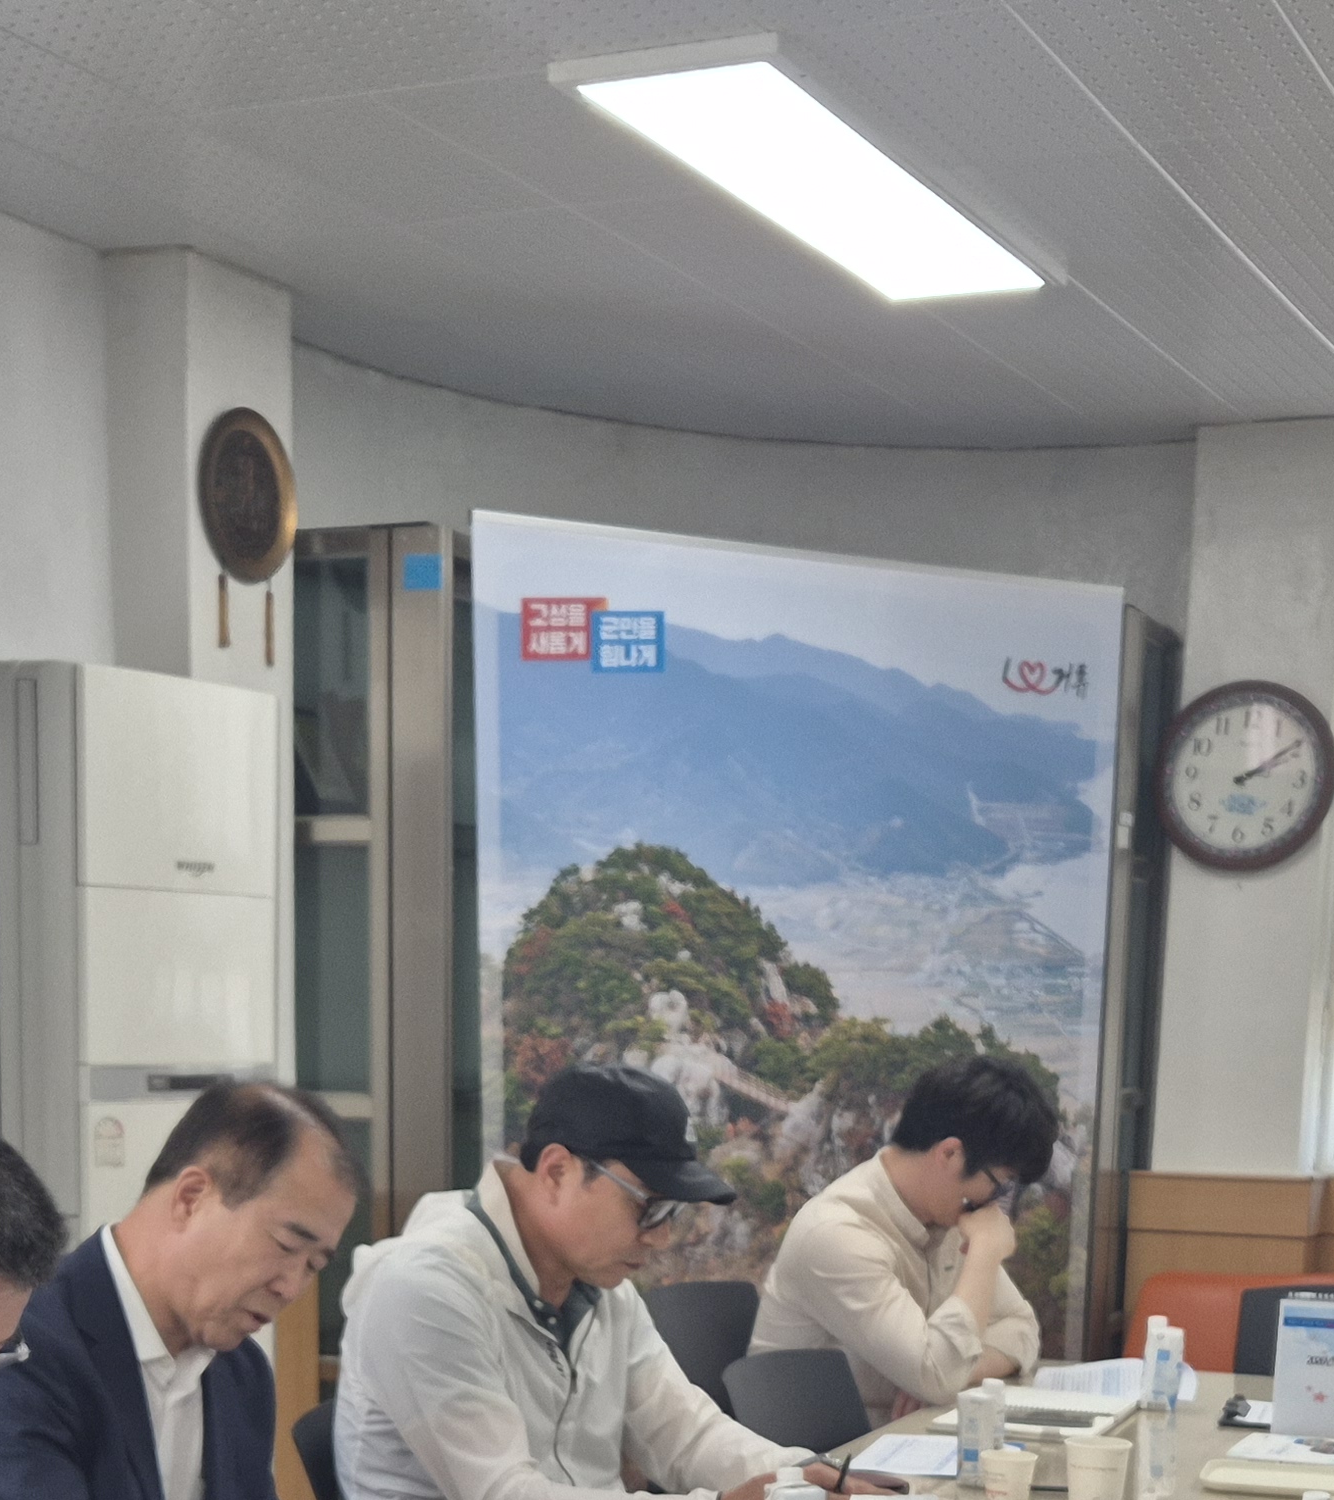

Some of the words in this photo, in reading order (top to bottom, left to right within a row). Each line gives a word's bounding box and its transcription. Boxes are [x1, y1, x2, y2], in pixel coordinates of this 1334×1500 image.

[528, 604, 587, 628] 고성을
[601, 616, 657, 641] 군민을
[528, 631, 587, 655] 새롭게
[600, 643, 657, 668] 힘나게
